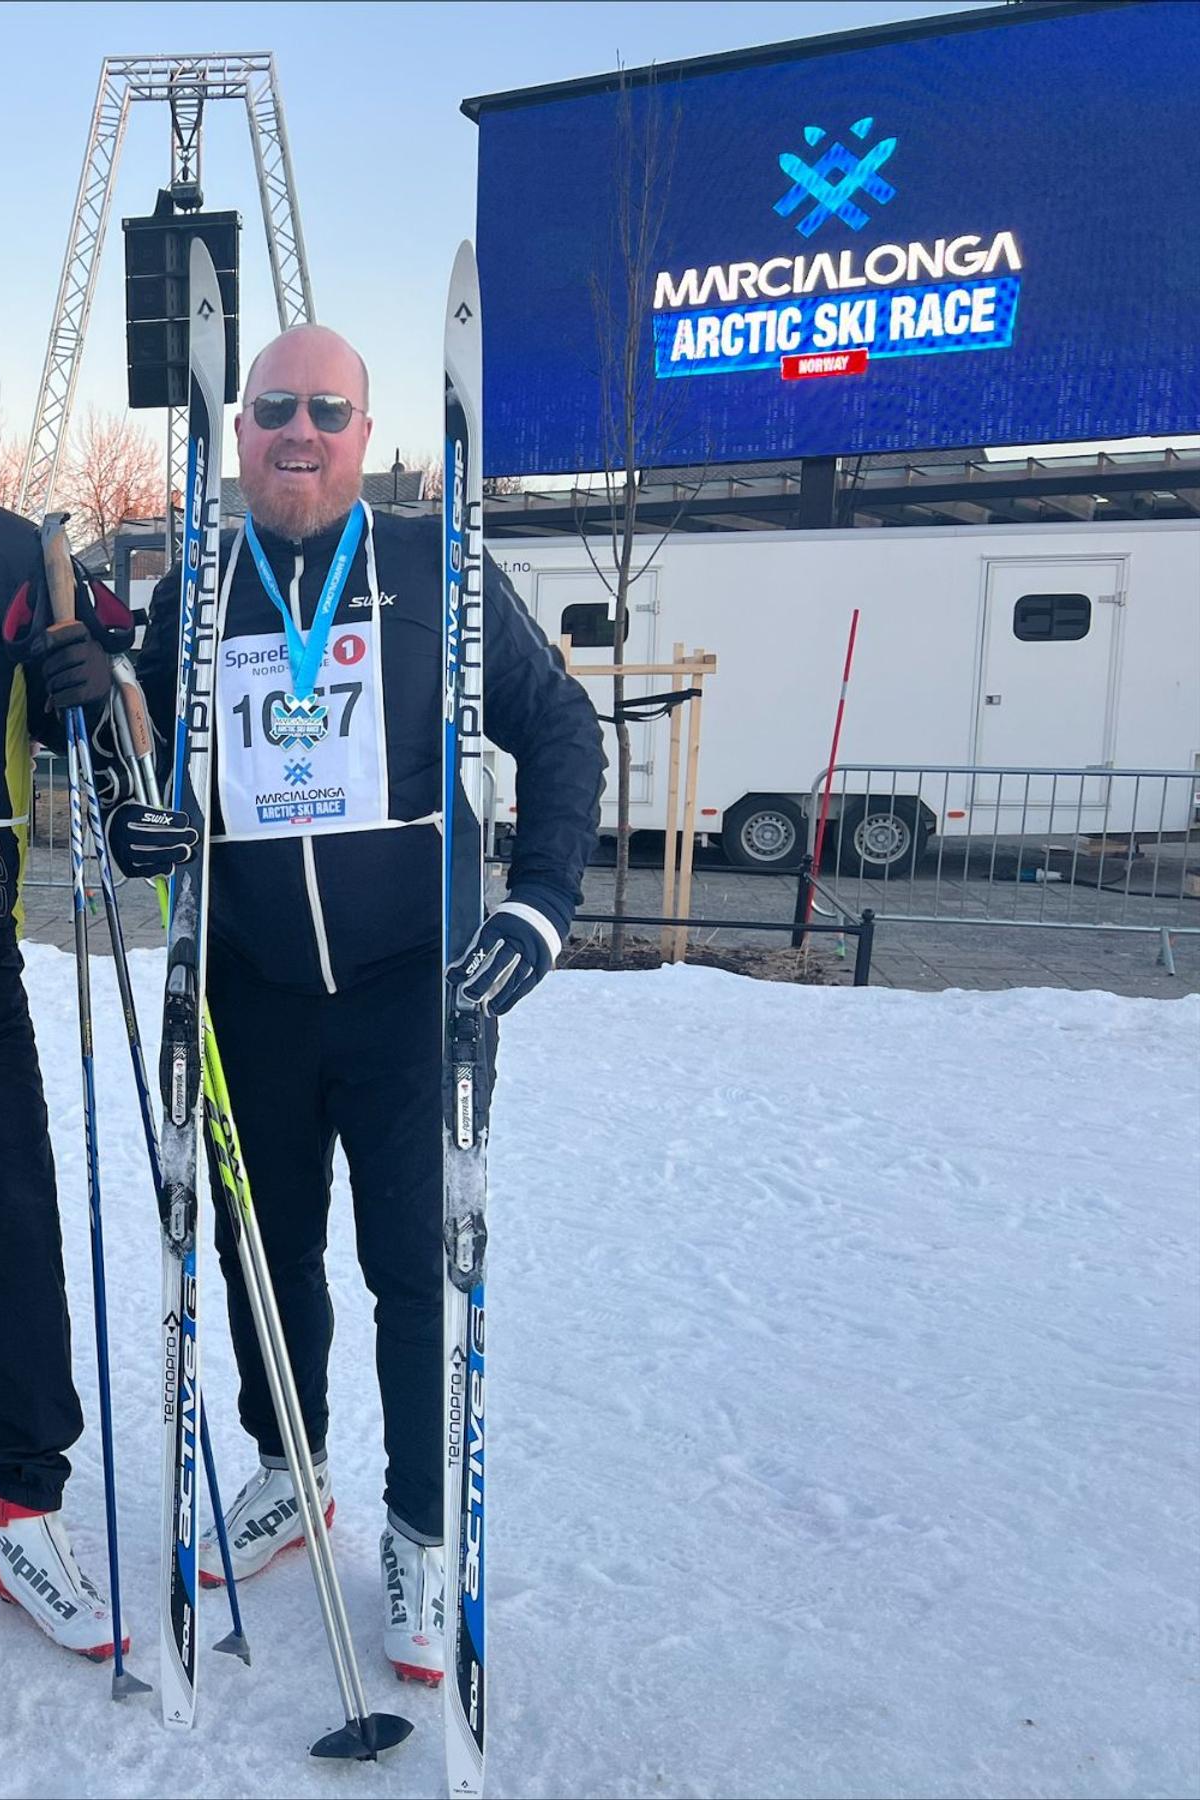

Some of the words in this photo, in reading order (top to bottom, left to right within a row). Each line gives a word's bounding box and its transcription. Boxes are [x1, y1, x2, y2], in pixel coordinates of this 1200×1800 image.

[652, 231, 1021, 309] MARCIALONGA
[671, 309, 800, 361] ARCTIC
[813, 300, 876, 349] SKI
[889, 285, 996, 342] RACE
[798, 354, 850, 376] NORWAY
[193, 437, 205, 530] GRIP
[453, 439, 464, 533] GRIP
[141, 812, 174, 826] swix
[256, 787, 345, 805] MARCIALONGA
[262, 804, 295, 819] ARCTIC
[297, 803, 314, 817] SKI
[316, 800, 341, 815] RACE
